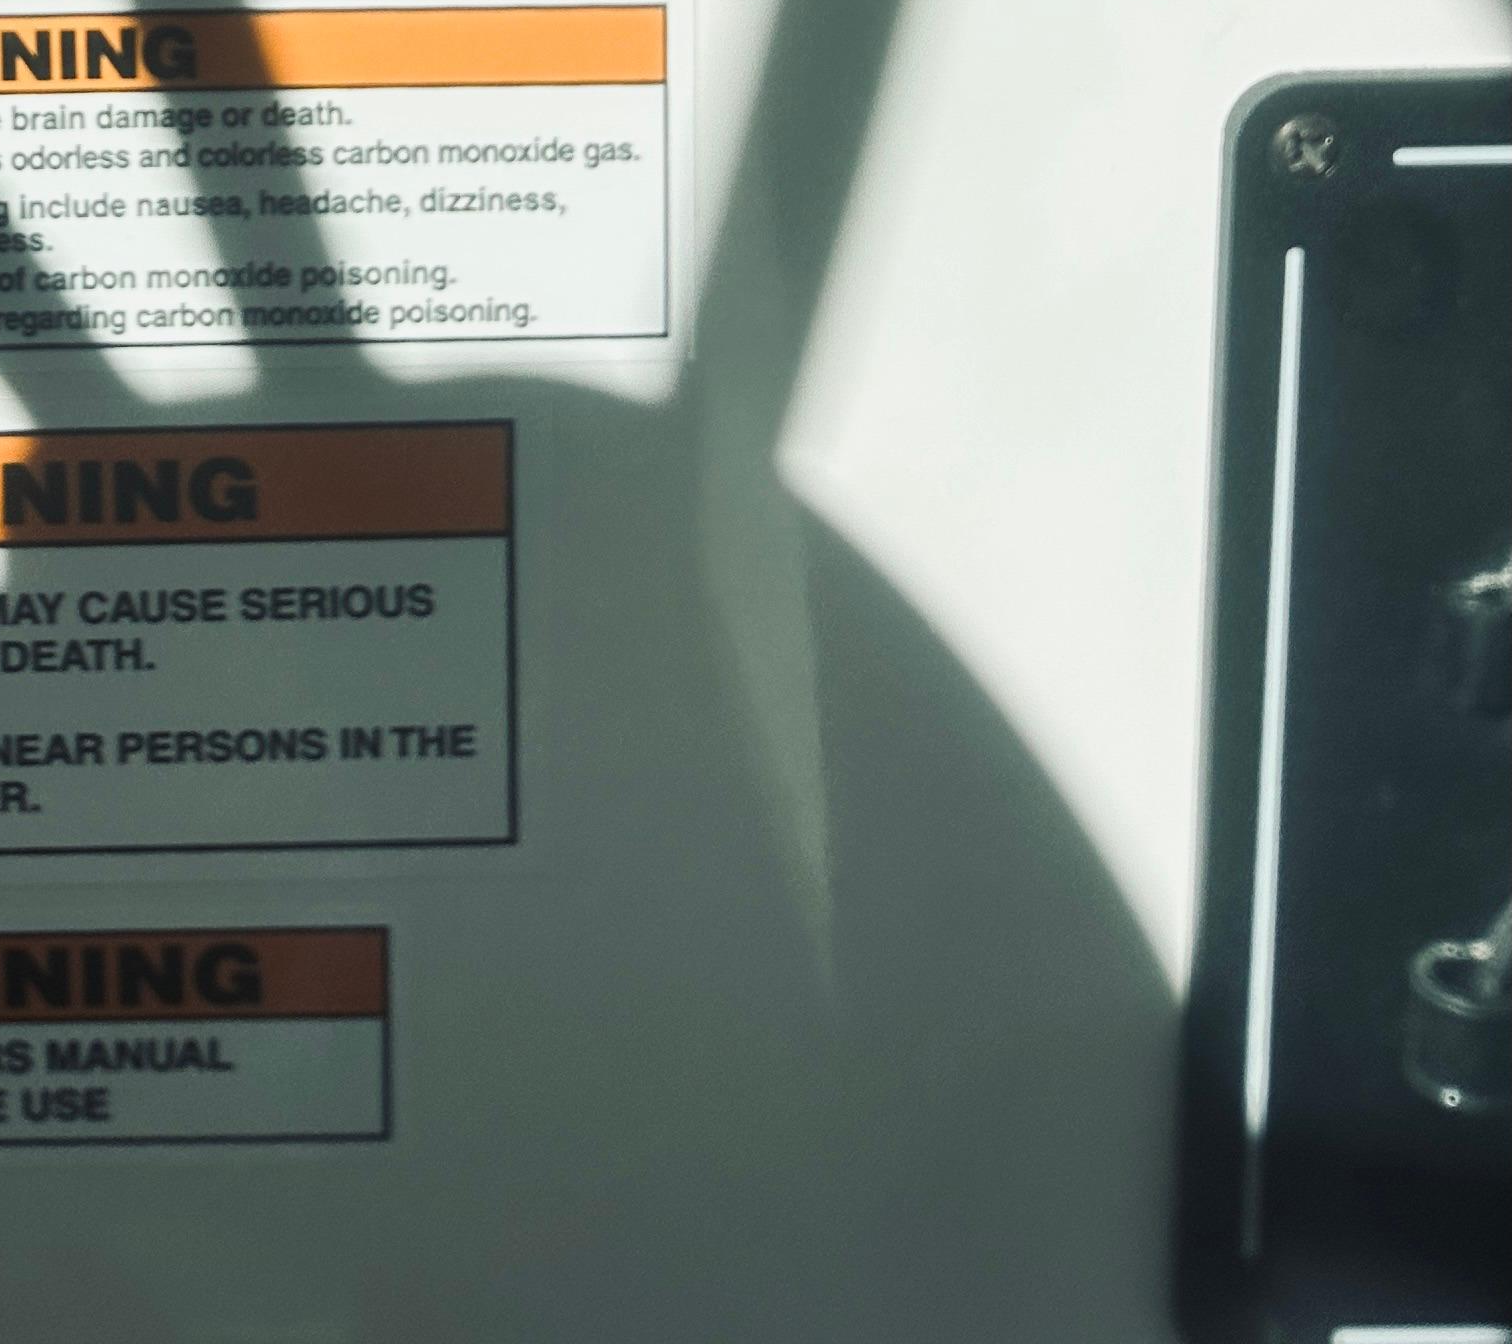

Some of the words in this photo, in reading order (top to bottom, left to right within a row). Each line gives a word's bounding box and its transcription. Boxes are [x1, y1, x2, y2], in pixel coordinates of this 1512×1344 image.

[12, 103, 86, 131] brain
[95, 102, 213, 133] damage
[221, 103, 254, 127] or
[262, 100, 353, 127] death.
[10, 143, 130, 171] odorless
[138, 143, 190, 170] and
[197, 141, 324, 168] colorless
[333, 138, 430, 166] carbon
[437, 136, 574, 164] monoxide
[584, 141, 640, 169] gas.
[18, 192, 126, 220] include
[135, 191, 252, 222] nausea,
[258, 188, 411, 220] headache,
[419, 185, 567, 216] dizziness,
[34, 264, 137, 291] carbon
[147, 261, 291, 289] monoxide
[301, 260, 457, 293] poisoning.
[136, 302, 235, 330] carbon
[242, 300, 380, 328] monoxide
[389, 298, 537, 330] poisoning.
[77, 588, 228, 624] CAUSE
[240, 583, 436, 622] SERIOUS
[116, 728, 327, 765] PERSONS
[340, 727, 385, 760] IN
[390, 724, 478, 759] THE
[46, 1036, 233, 1074] MANUAL
[22, 1086, 111, 1121] USE
